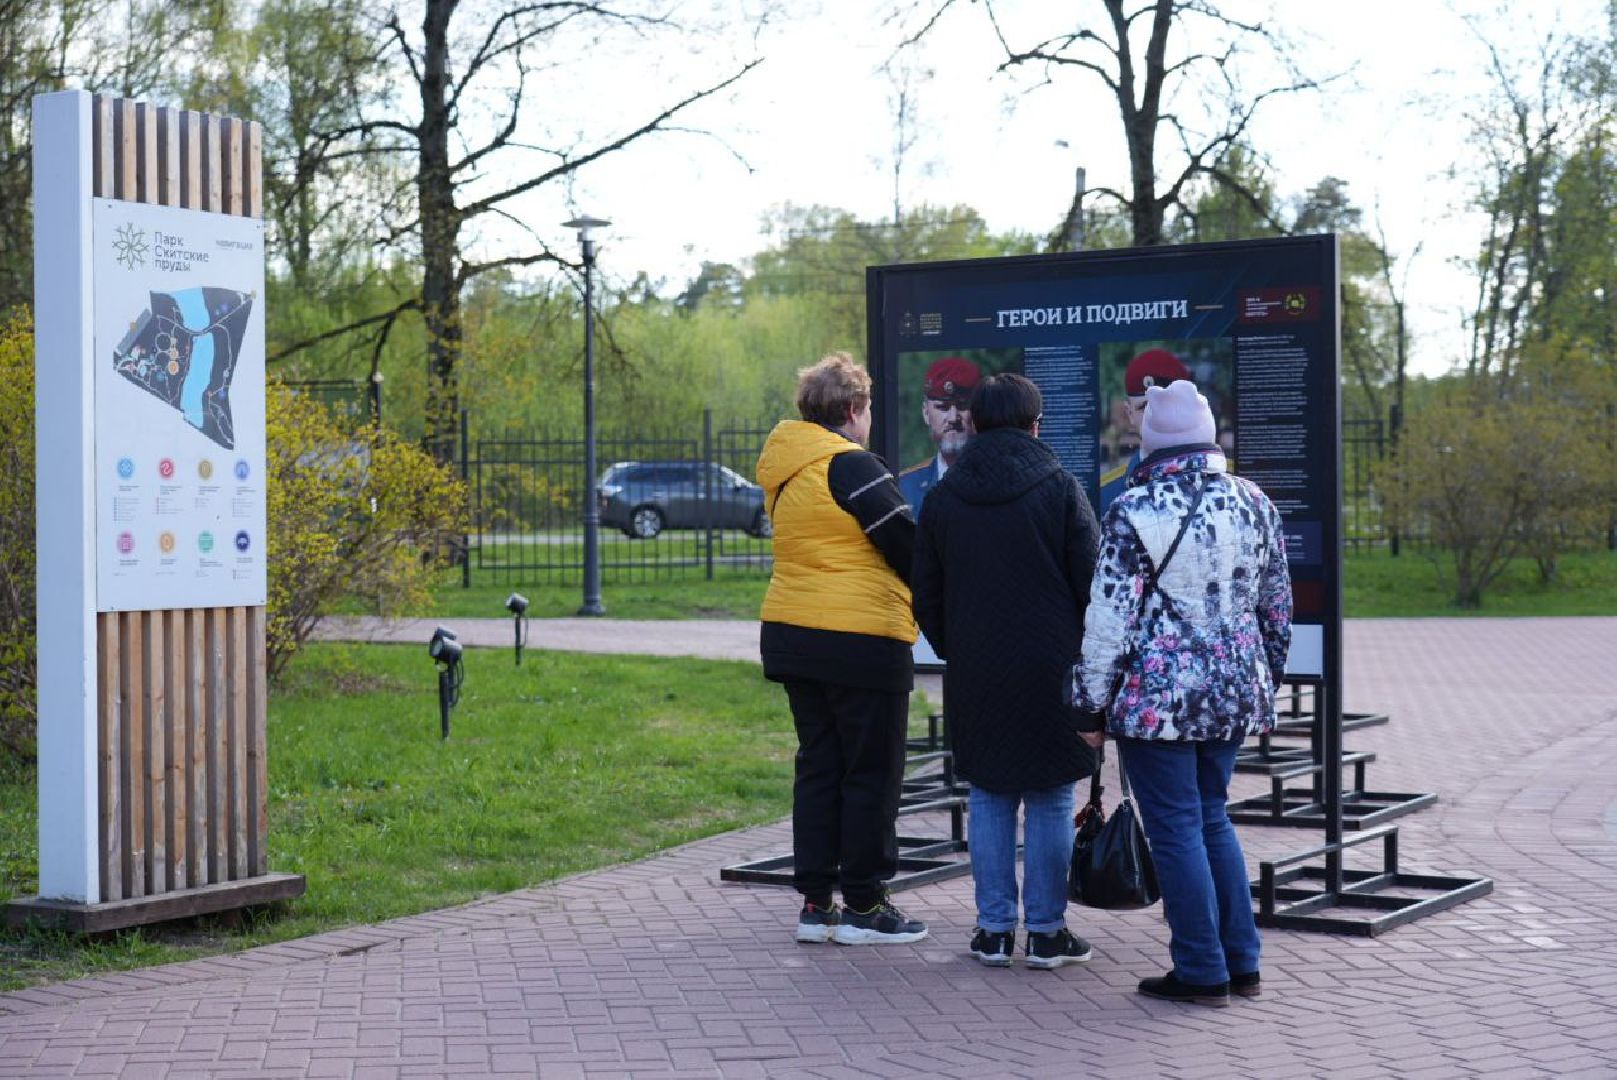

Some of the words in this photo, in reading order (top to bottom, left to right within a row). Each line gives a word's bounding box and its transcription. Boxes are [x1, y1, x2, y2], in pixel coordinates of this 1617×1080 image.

[154, 231, 184, 248] Парк
[154, 245, 209, 263] Скитские
[154, 259, 191, 272] пруды
[996, 307, 1062, 328] ГЕРОИ
[1066, 306, 1082, 324] И
[1086, 300, 1188, 325] ПОДВИГИ
